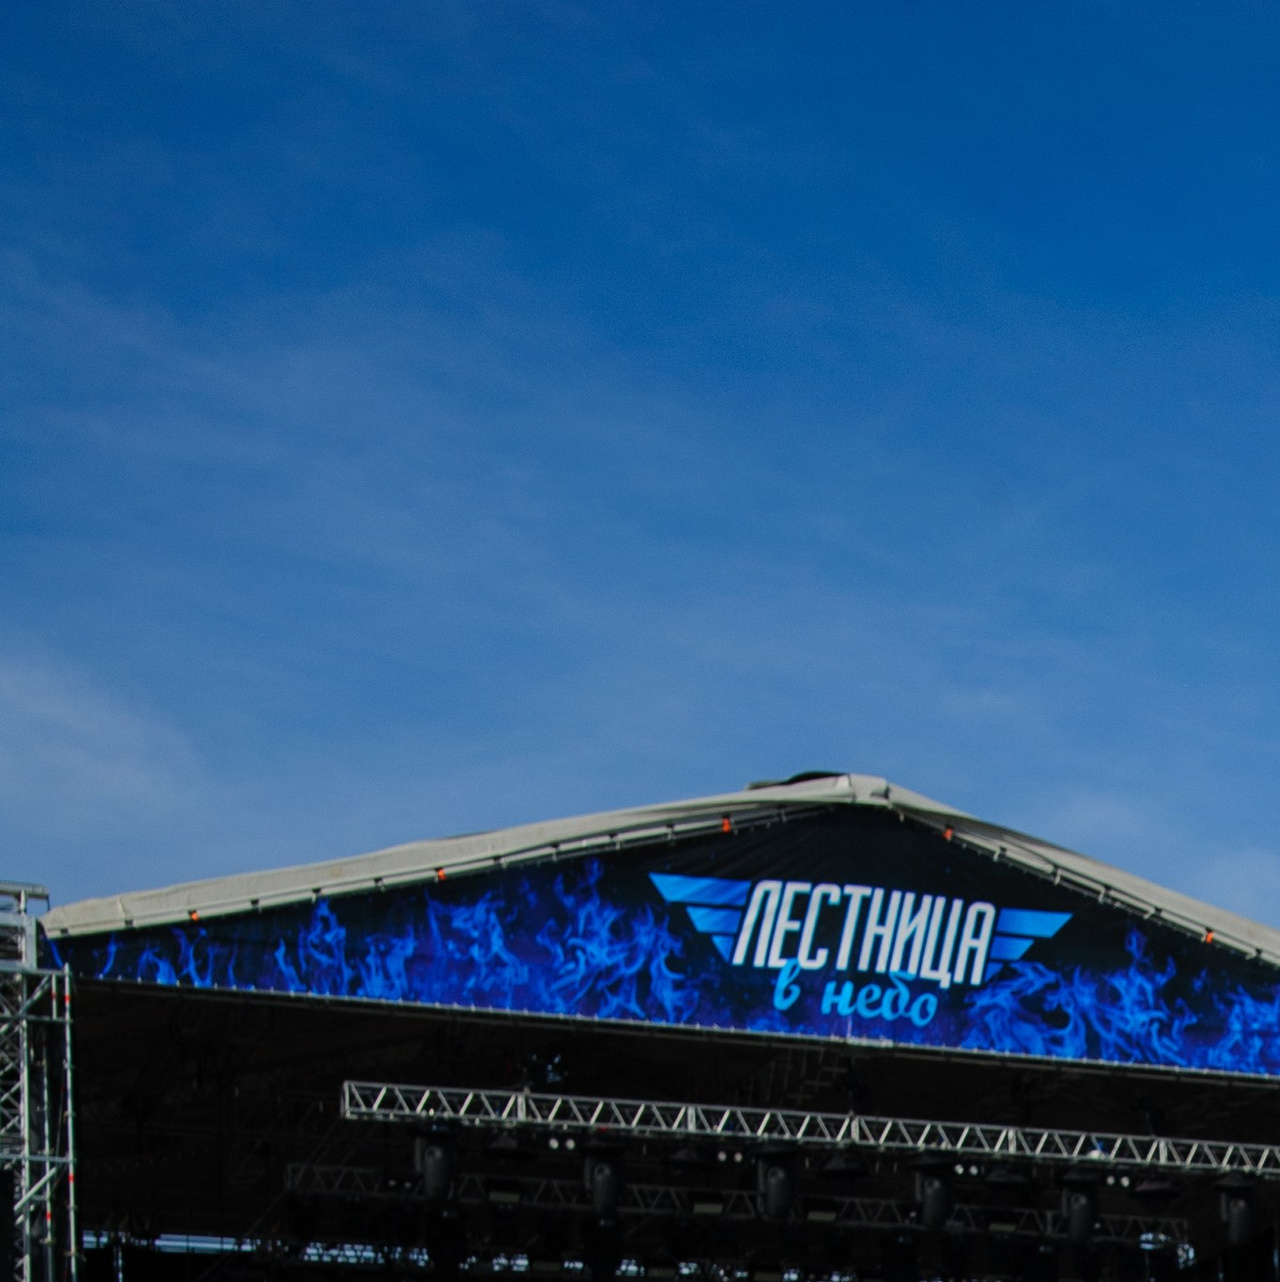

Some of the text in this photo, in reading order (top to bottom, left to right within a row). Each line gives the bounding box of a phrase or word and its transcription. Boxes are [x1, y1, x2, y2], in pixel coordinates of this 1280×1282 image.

[732, 879, 996, 989] ЛЕСТНИЦА
[772, 957, 938, 1027] в небо
